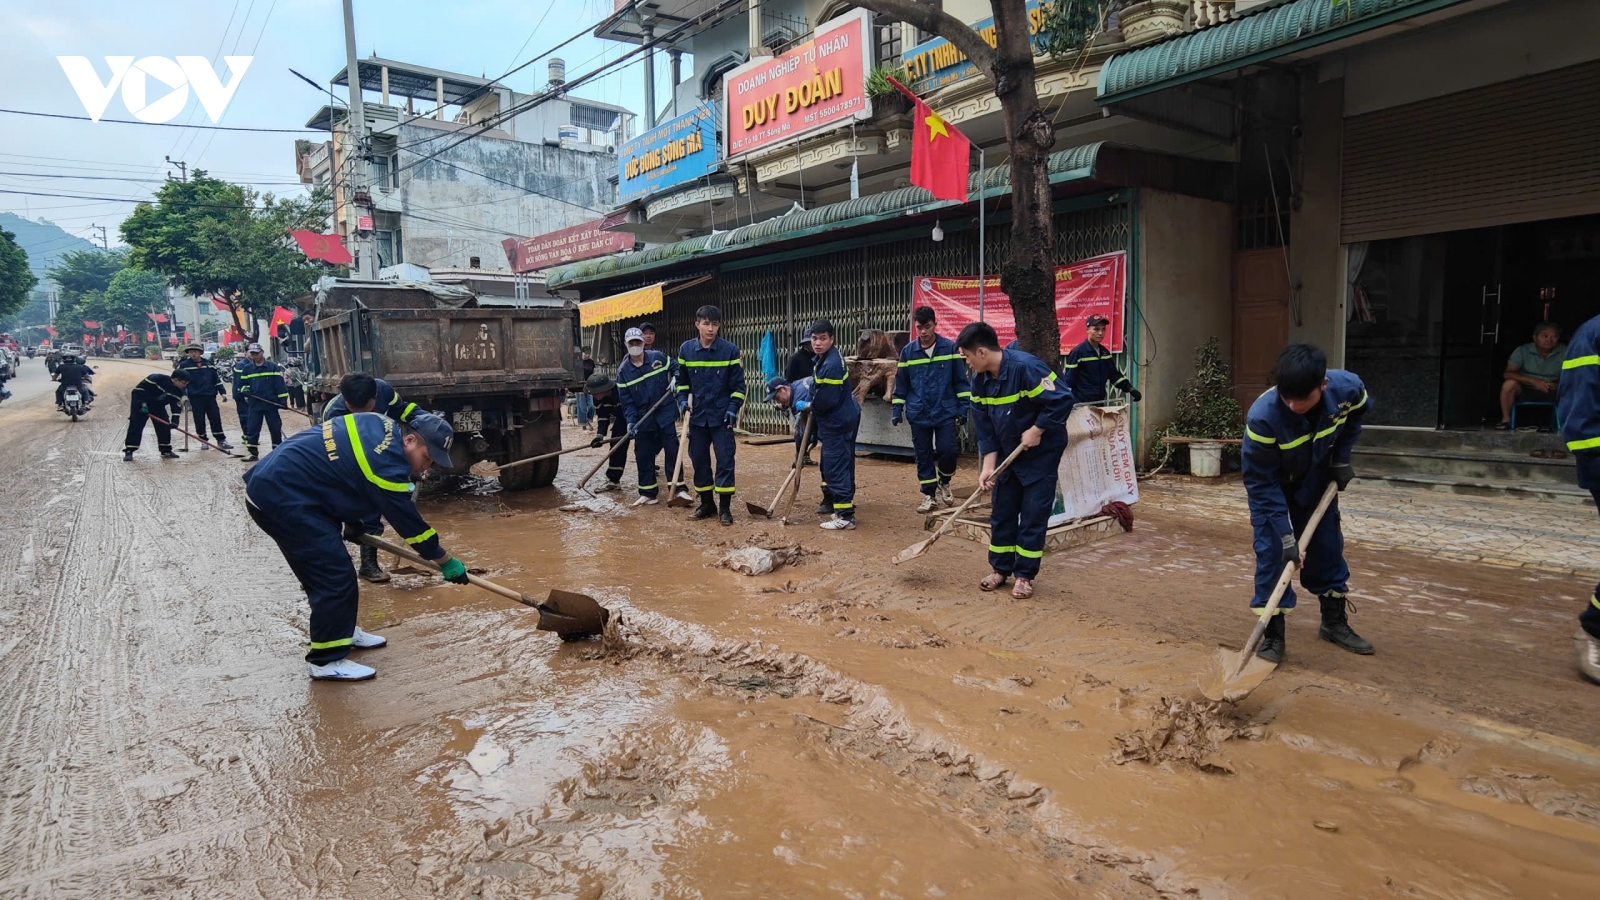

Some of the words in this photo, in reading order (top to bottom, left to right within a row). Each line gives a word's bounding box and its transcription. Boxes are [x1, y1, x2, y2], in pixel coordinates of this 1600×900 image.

[738, 72, 767, 95] DOANH
[769, 56, 800, 78] NGHIỆP
[803, 46, 817, 65] TƯ
[819, 34, 849, 57] NHÂN
[929, 43, 957, 71] TNHH
[743, 93, 779, 130] DUY
[785, 67, 843, 114] ĐOÀN
[804, 112, 817, 123] MST
[819, 97, 861, 118] 5500478971
[662, 138, 686, 165] SÔNG
[578, 243, 590, 253] KHU
[591, 239, 604, 251] DÂN
[605, 235, 615, 247] CƯ
[580, 228, 592, 241] XÂY
[460, 412, 475, 421] 26C
[1121, 446, 1130, 468] TEM
[1124, 472, 1135, 496] GIẤY
